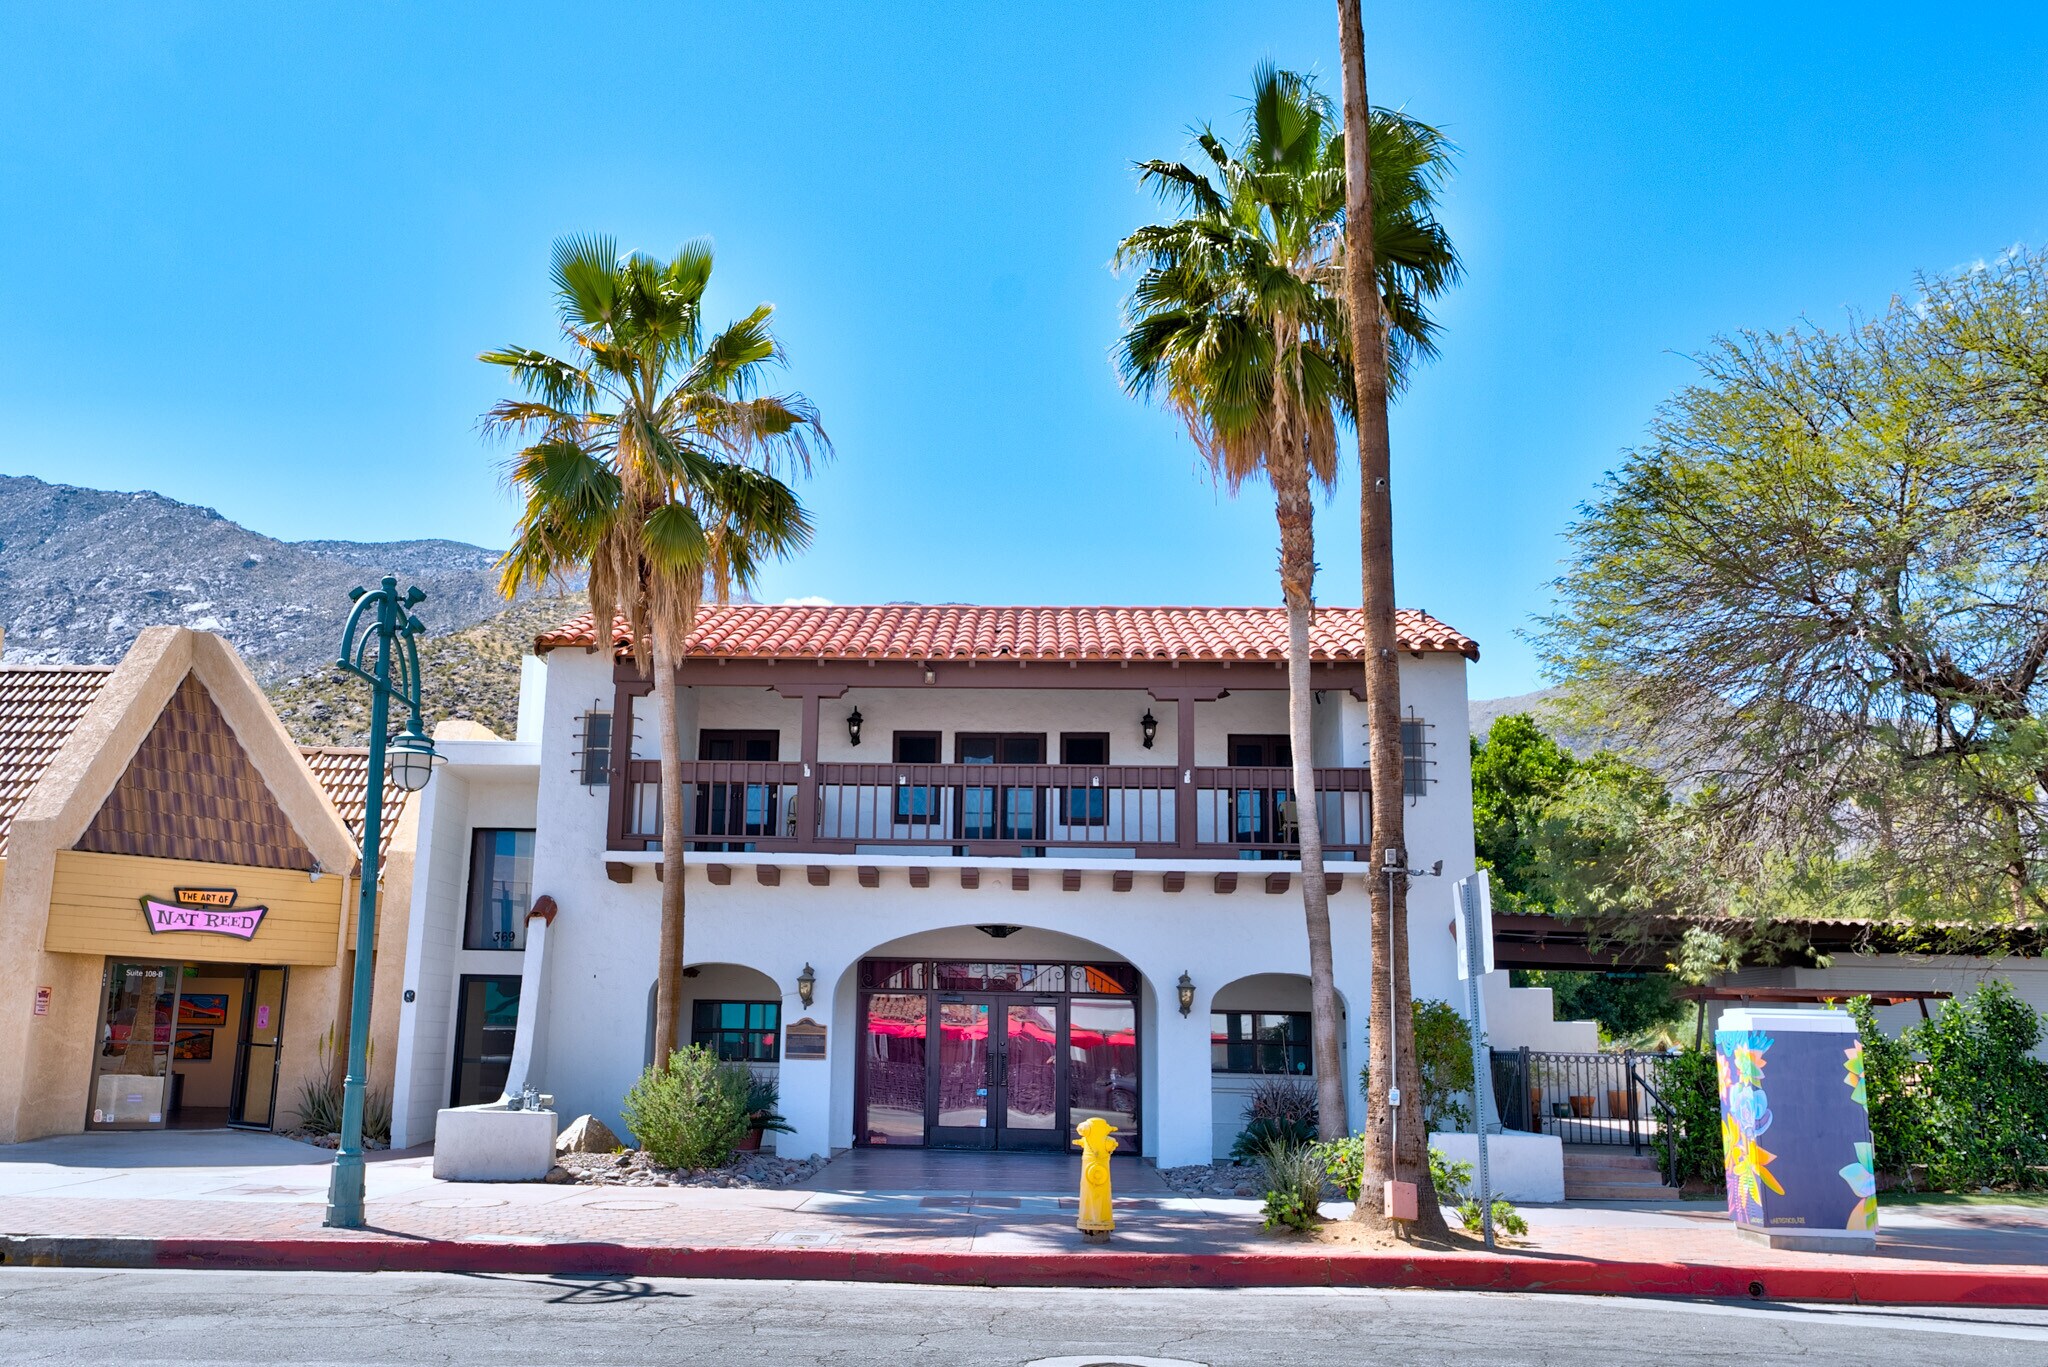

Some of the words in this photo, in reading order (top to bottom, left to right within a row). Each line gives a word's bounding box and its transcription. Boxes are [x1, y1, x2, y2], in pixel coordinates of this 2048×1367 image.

[182, 892, 197, 901] THE
[200, 893, 216, 902] ART
[218, 895, 229, 904] OF
[156, 909, 199, 927] NAT
[203, 913, 255, 929] REED
[492, 931, 515, 942] 369
[126, 969, 144, 977] Suite
